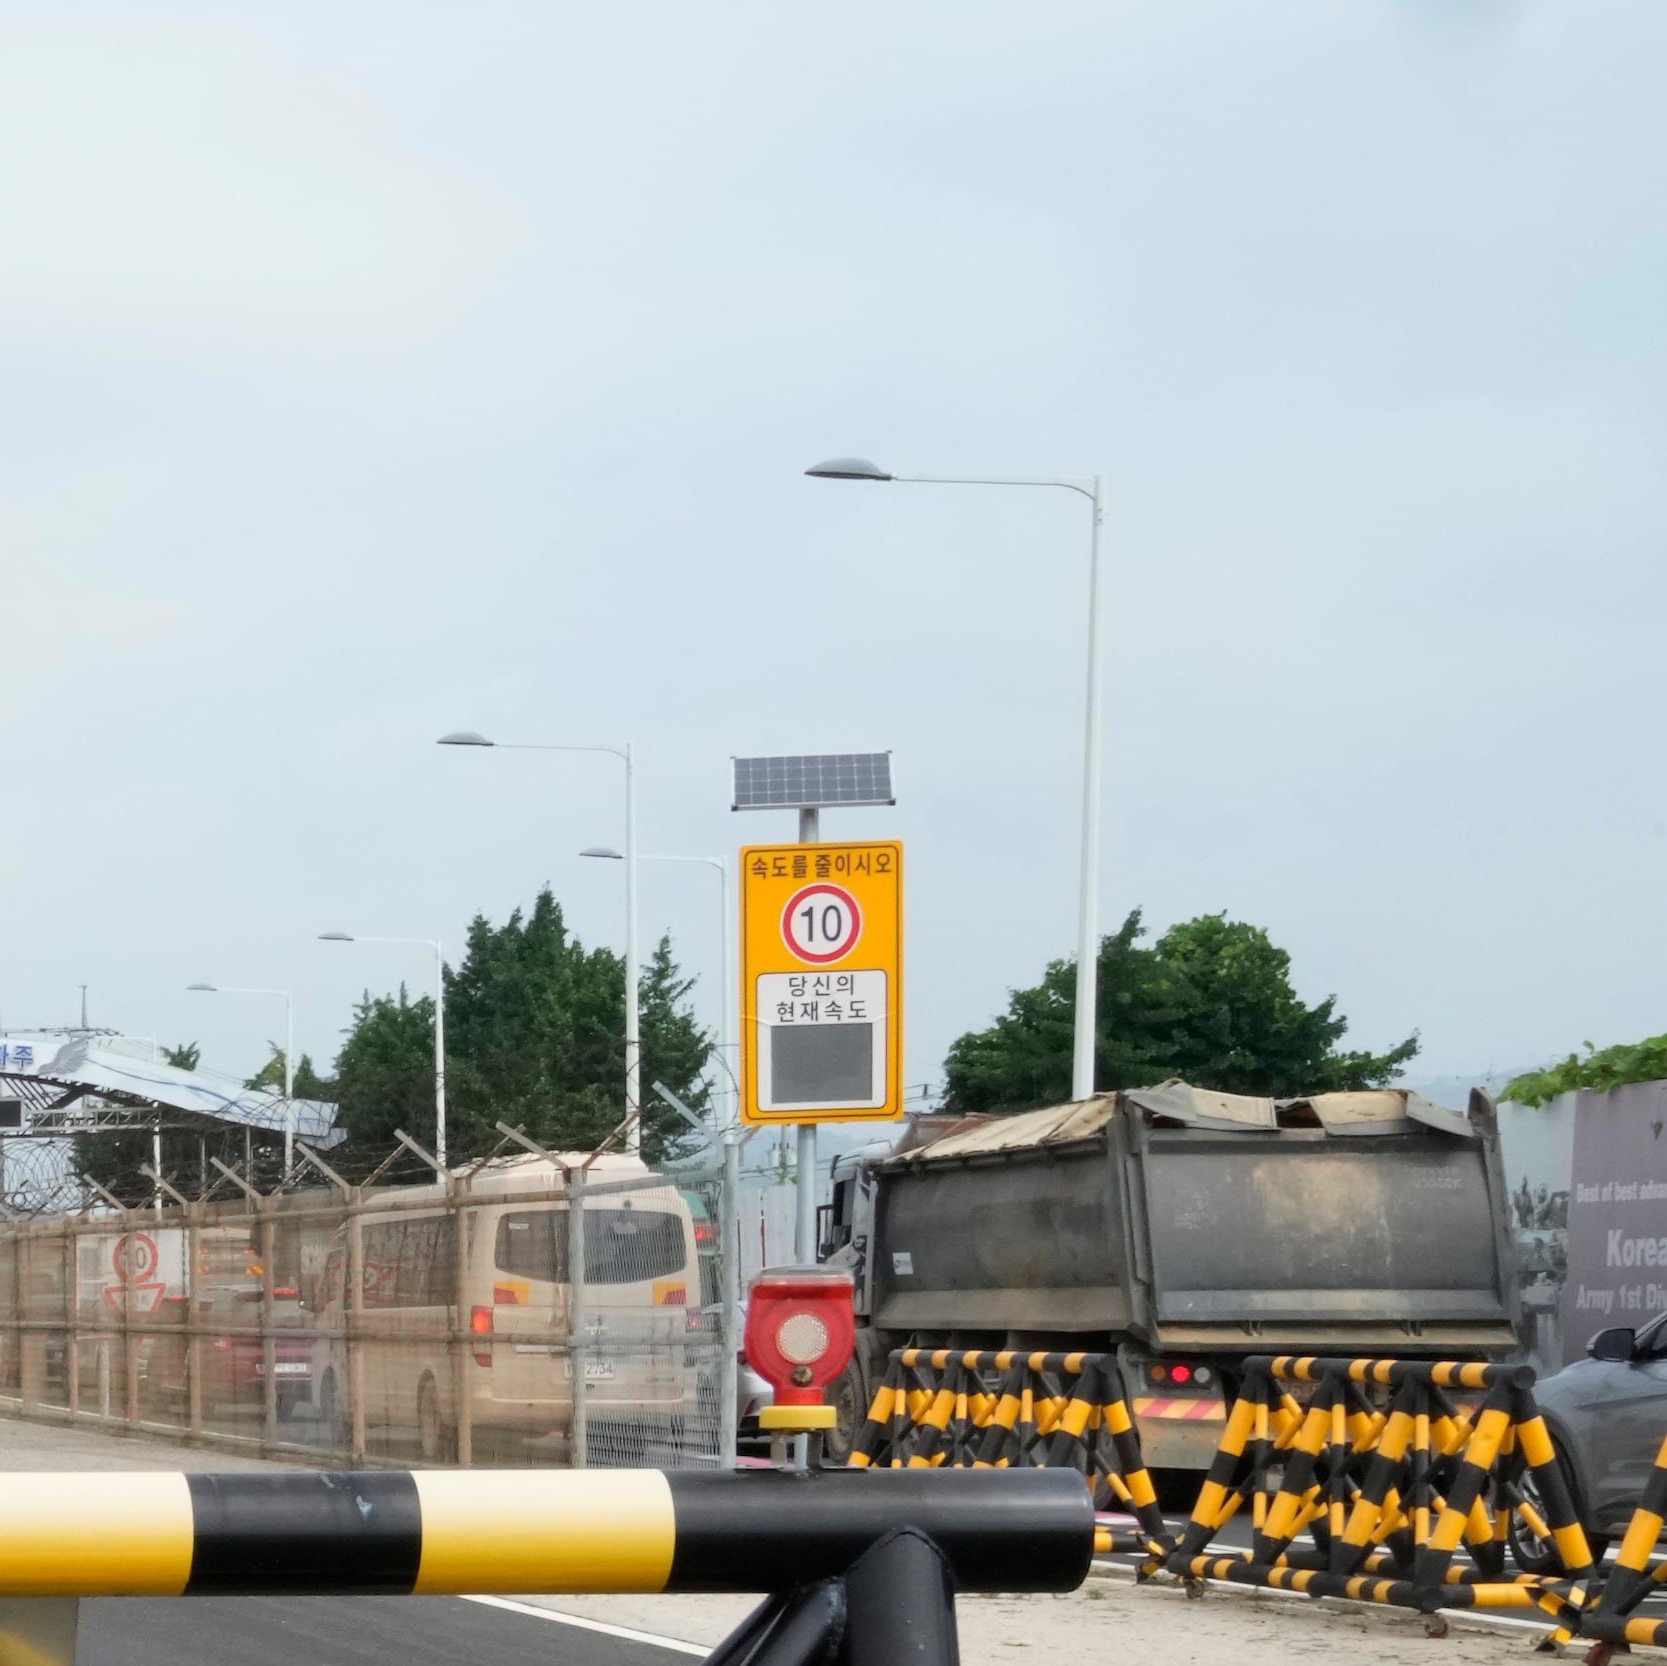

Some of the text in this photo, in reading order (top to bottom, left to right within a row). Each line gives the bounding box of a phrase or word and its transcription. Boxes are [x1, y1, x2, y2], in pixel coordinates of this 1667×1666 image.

[751, 853, 892, 880] 속도를 줄이시오
[800, 904, 843, 943] 10
[788, 974, 855, 998] 당신의
[776, 1000, 868, 1024] 현재속도
[1576, 1284, 1615, 1315] Army
[1619, 1284, 1642, 1310] 1st
